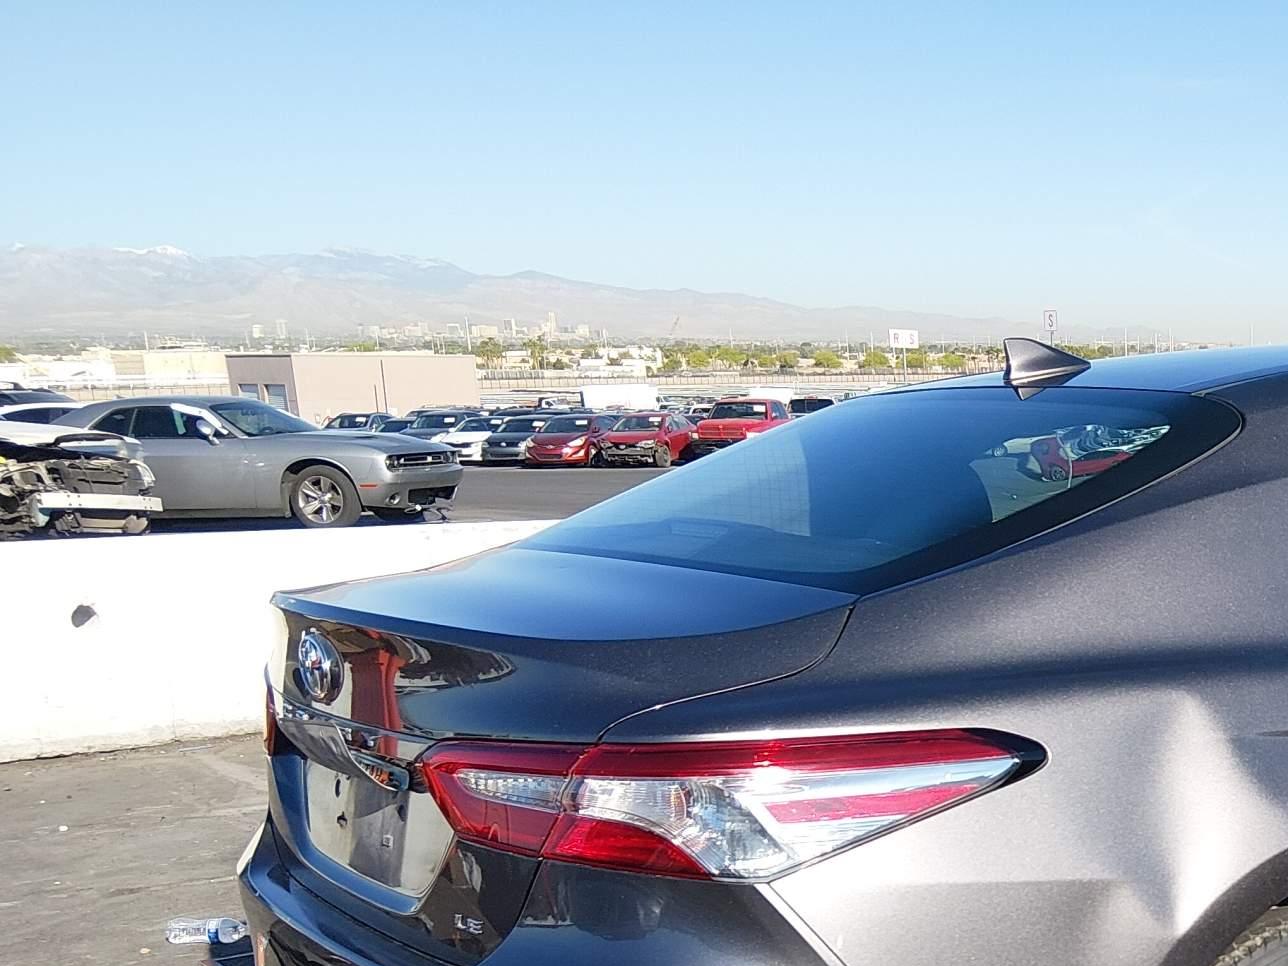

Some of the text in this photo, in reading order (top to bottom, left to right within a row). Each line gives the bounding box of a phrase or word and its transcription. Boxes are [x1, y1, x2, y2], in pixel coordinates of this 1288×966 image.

[1048, 313, 1054, 328] S
[893, 332, 900, 345] R
[453, 913, 485, 935] LE
